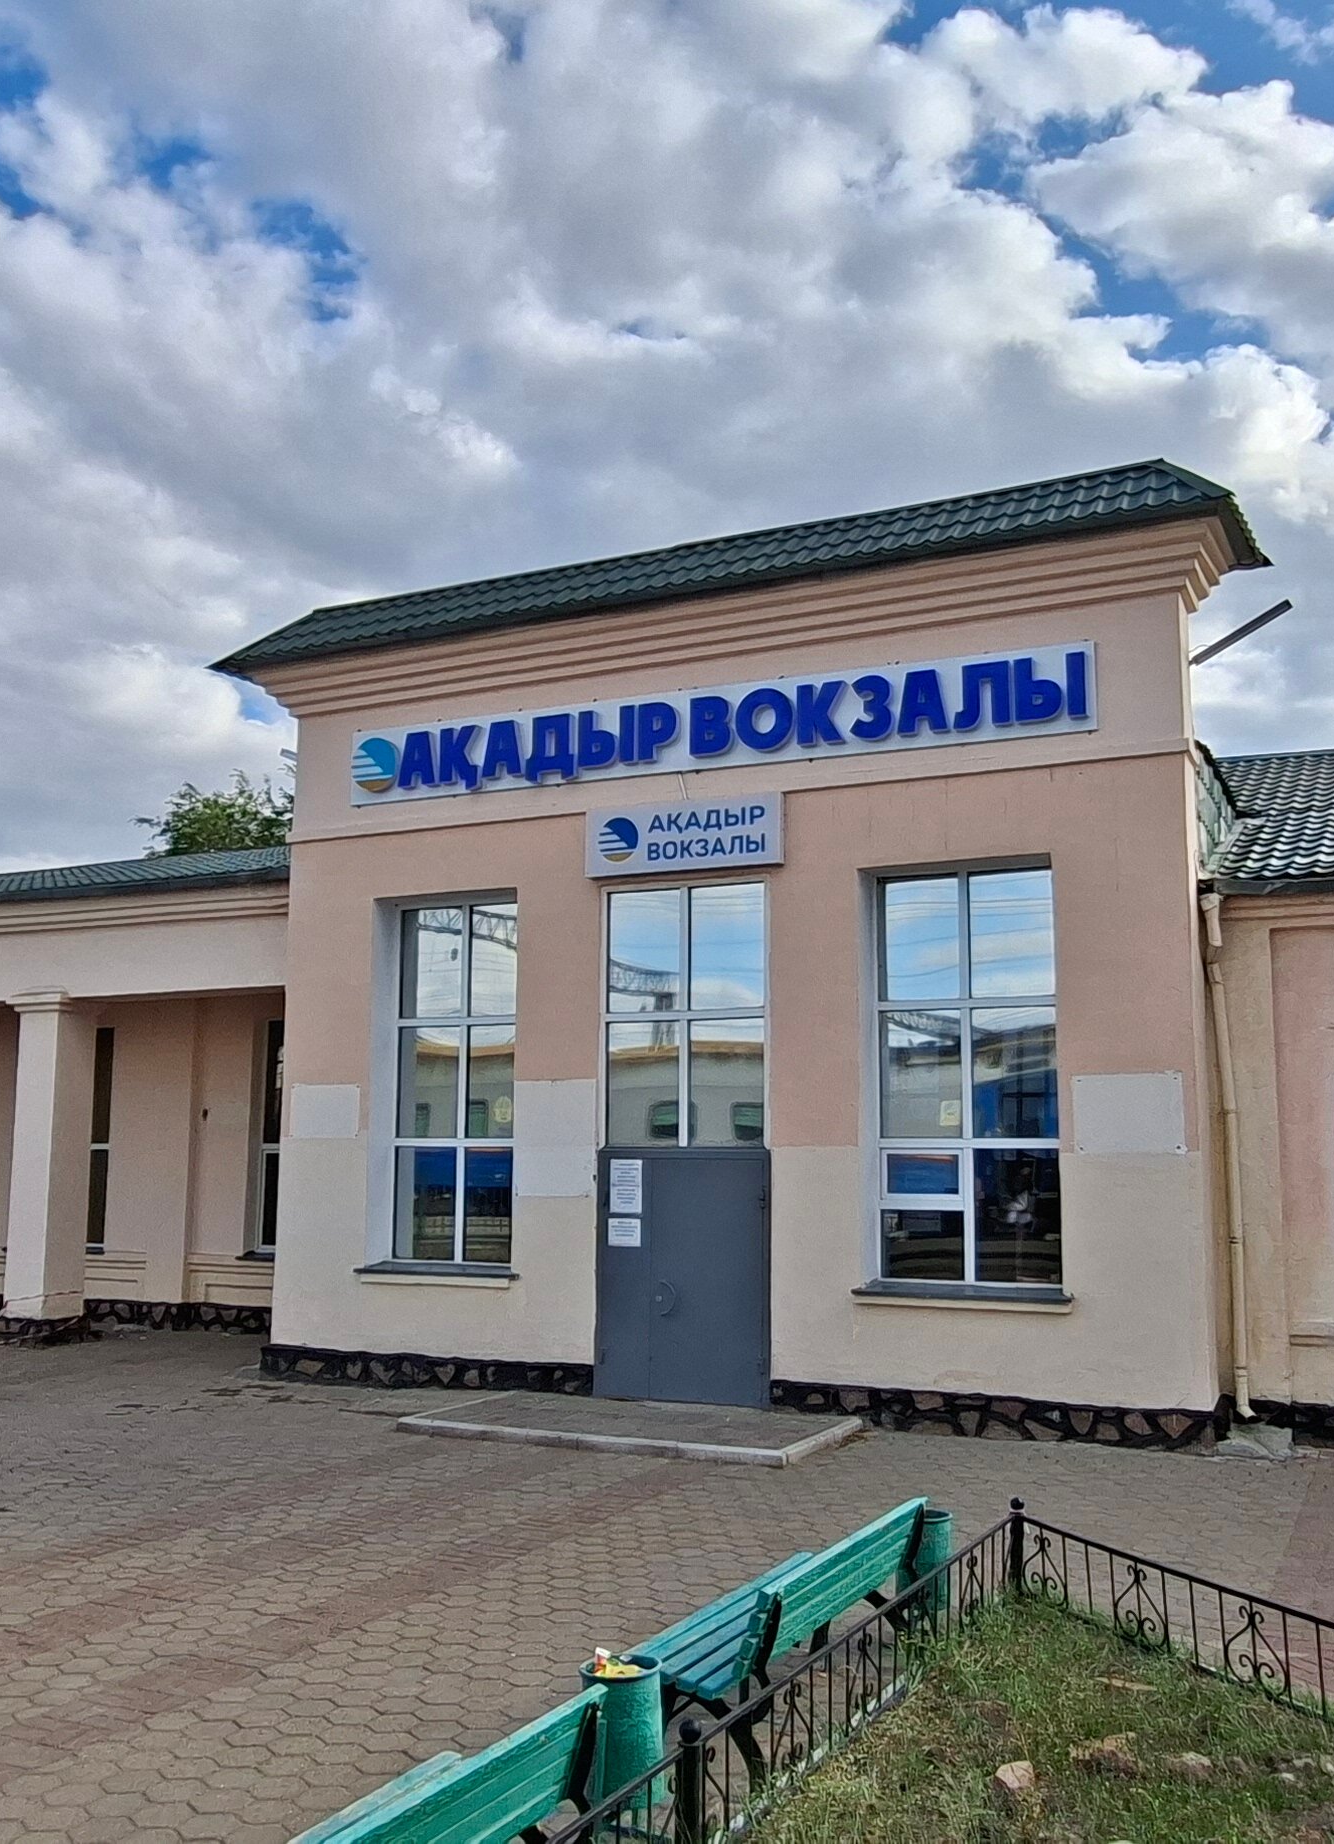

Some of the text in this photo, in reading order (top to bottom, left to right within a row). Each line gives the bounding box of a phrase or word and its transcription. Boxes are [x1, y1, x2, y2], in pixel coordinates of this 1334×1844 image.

[398, 651, 1089, 791] АҚАДЫР ВОКЗАЛЫ
[648, 805, 765, 834] АҚАДЫР
[647, 833, 766, 862] ВОКЗАЛЫ
